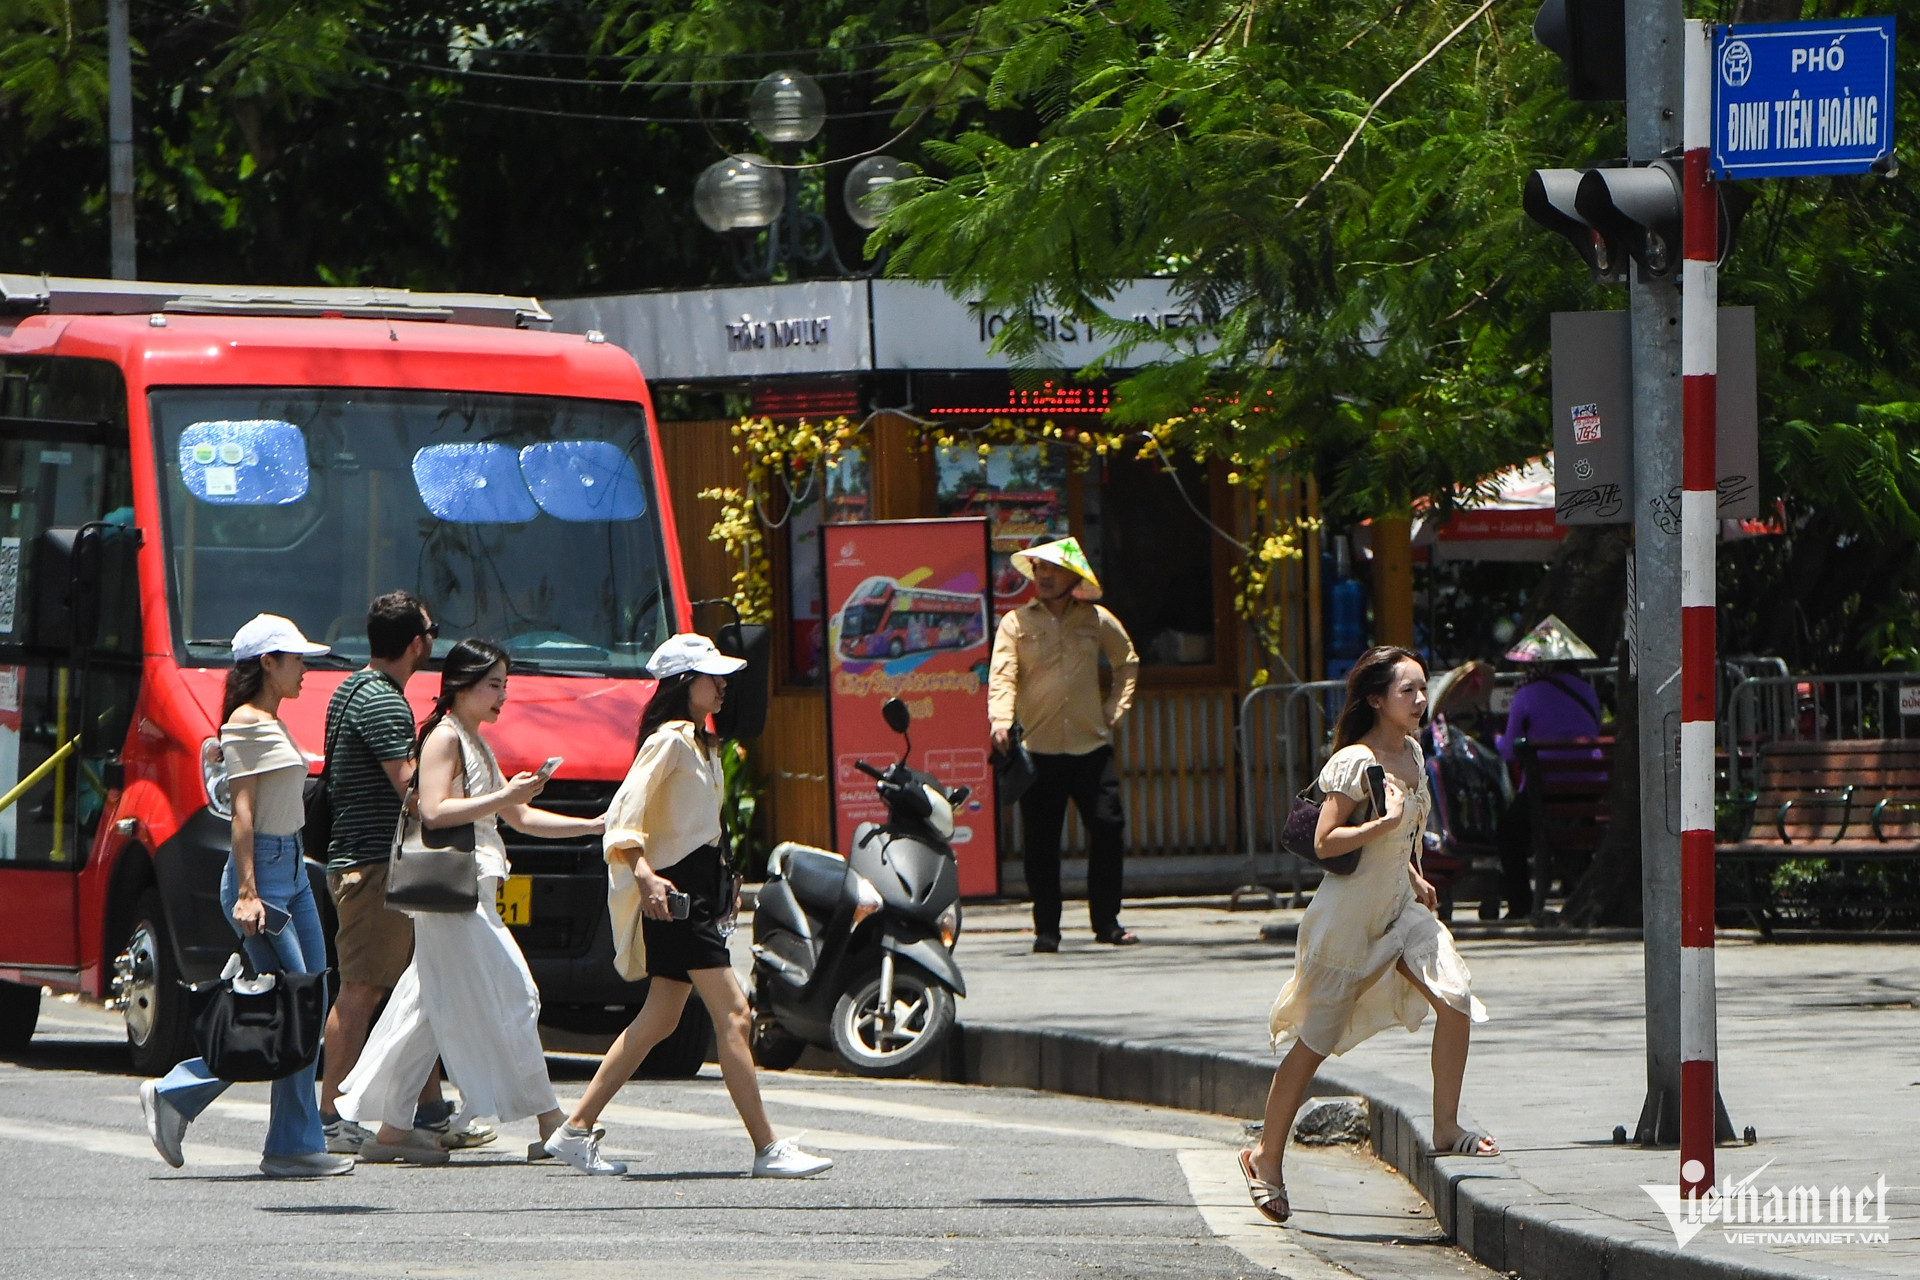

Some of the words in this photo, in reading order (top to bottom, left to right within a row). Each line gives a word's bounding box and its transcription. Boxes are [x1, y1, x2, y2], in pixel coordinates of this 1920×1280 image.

[1791, 35, 1845, 73] PHỐ
[1728, 101, 1770, 152] ĐINH
[1775, 89, 1813, 150] TIÊN
[1817, 86, 1878, 148] HOÀNG
